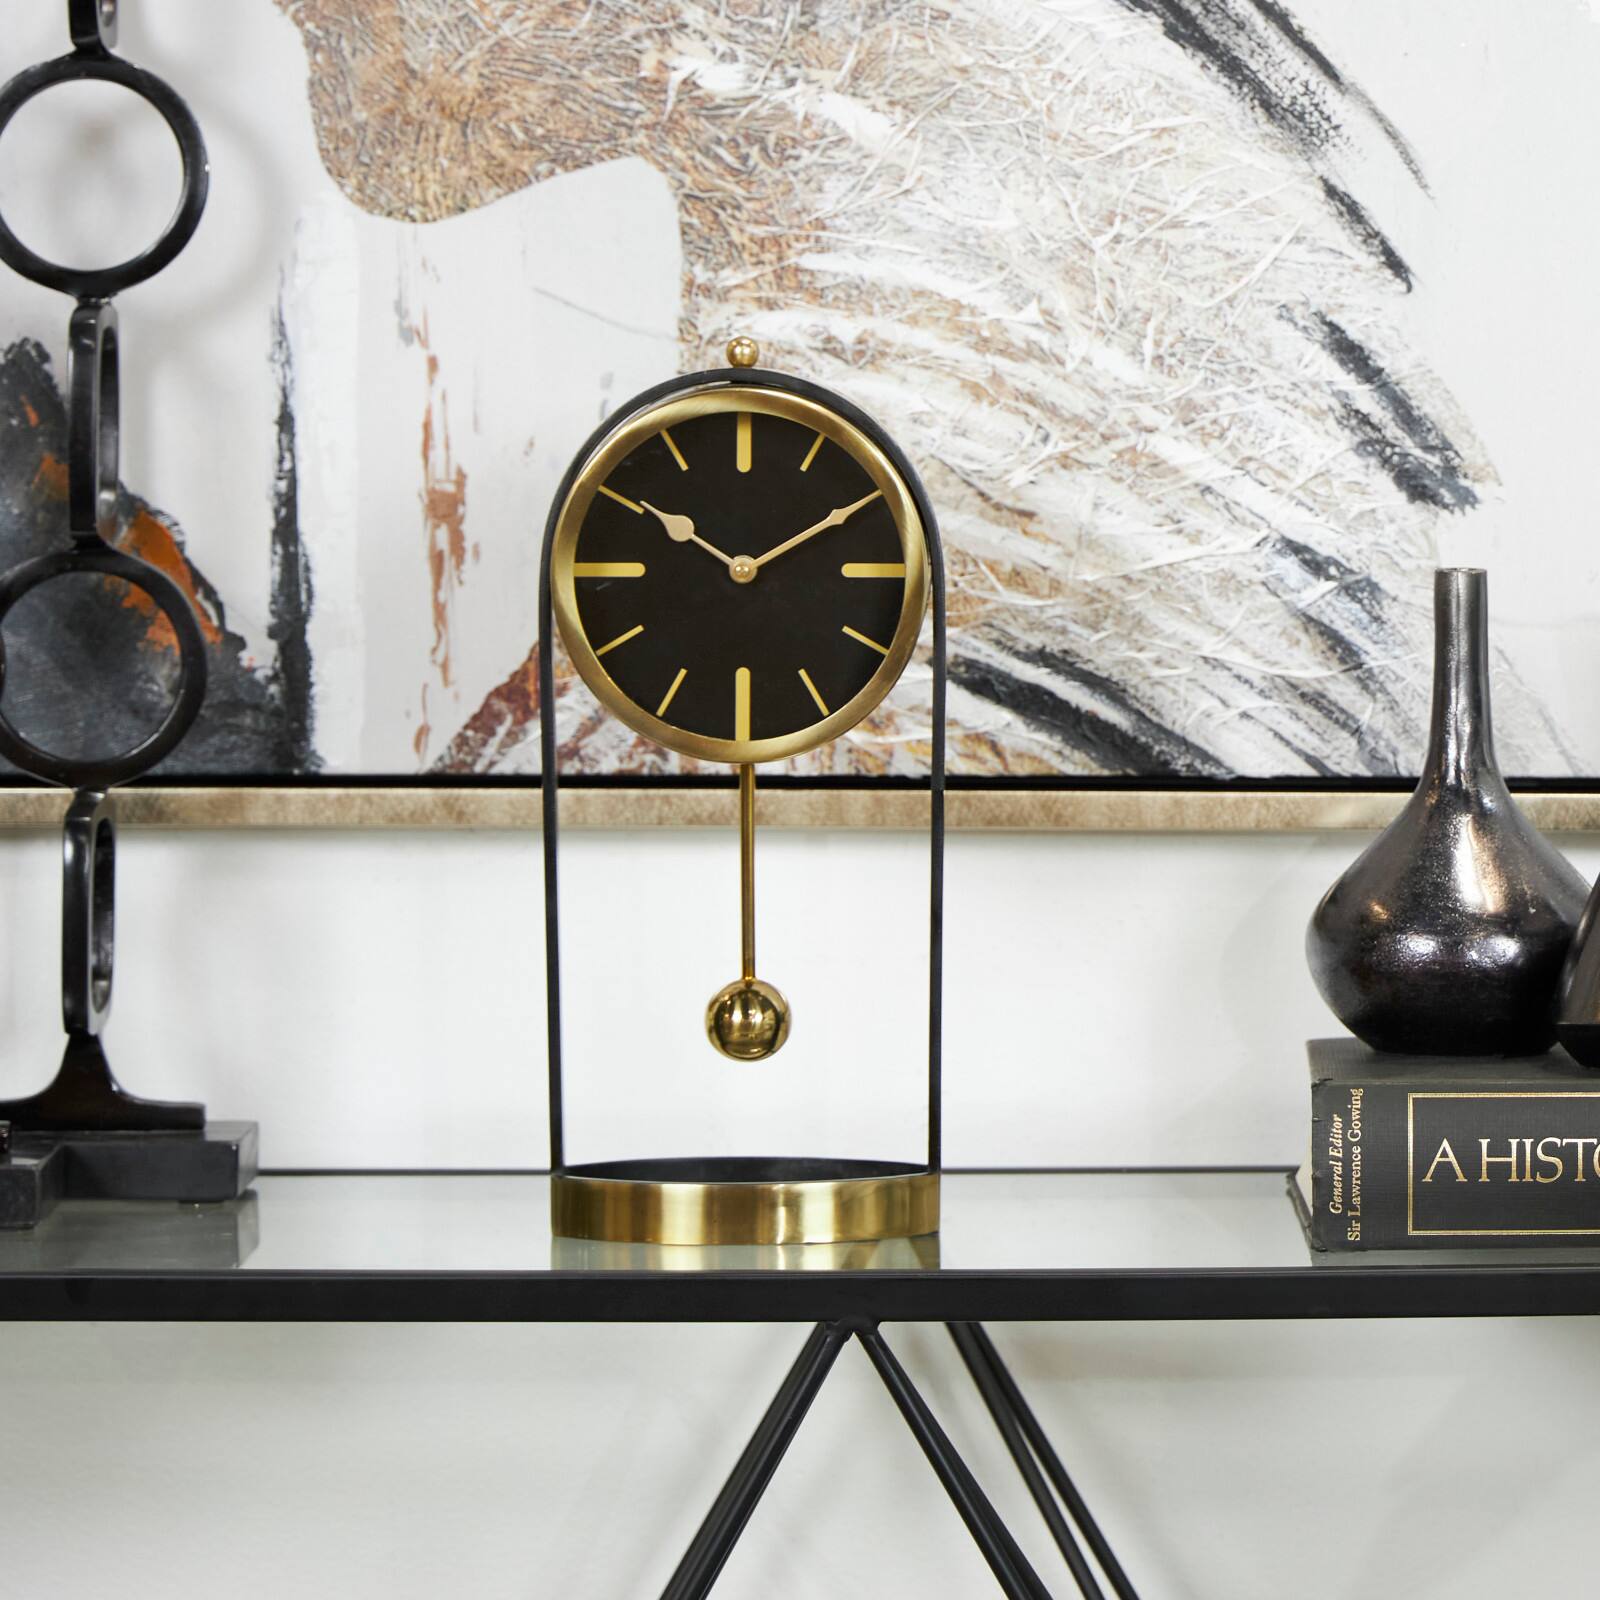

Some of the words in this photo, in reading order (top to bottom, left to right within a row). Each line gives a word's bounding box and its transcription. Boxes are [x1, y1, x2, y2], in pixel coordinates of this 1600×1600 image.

[1329, 1114, 1343, 1158] Editor
[1347, 1088, 1364, 1142] Gowing
[1347, 1146, 1361, 1217] Lawrence
[1422, 1137, 1468, 1182] A
[1478, 1137, 1600, 1184] HIST
[1329, 1161, 1343, 1214] General
[1347, 1220, 1361, 1241] Sir
